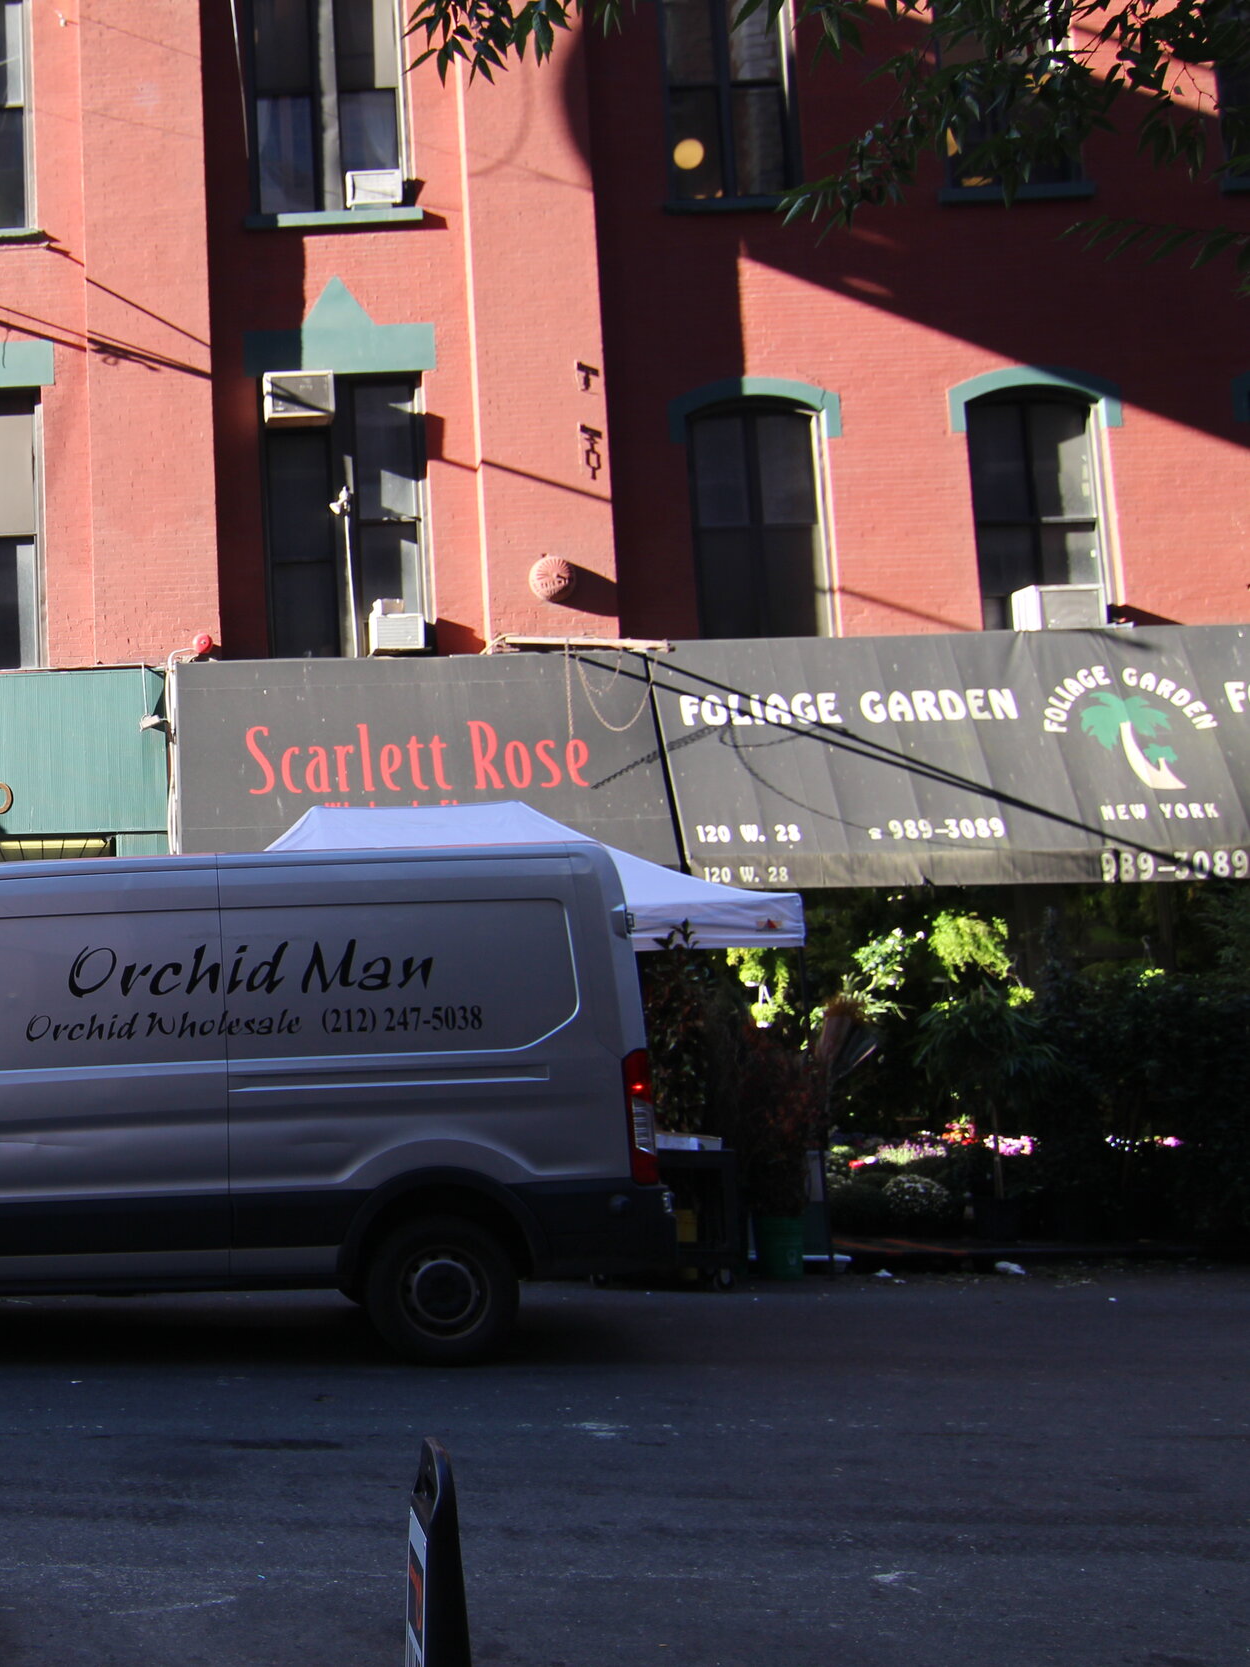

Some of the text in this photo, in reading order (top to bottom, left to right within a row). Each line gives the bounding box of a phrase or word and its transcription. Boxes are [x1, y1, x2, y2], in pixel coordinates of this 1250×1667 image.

[679, 689, 1019, 726] FOLIAGE GARDEN
[1043, 665, 1218, 733] FOLIAGE GARDEN
[1224, 681, 1250, 713] F
[244, 720, 589, 795] Scarlett Rose
[1100, 802, 1219, 820] NEW YORK
[695, 823, 801, 843] 120 W. 28
[888, 817, 1006, 840] 989-3089
[703, 866, 789, 883] 120 W. 28
[1101, 849, 1249, 883] 989-3089
[68, 939, 434, 998] Orchid Man
[25, 1005, 483, 1042] Orchid Wholesale (212) 247-5038
